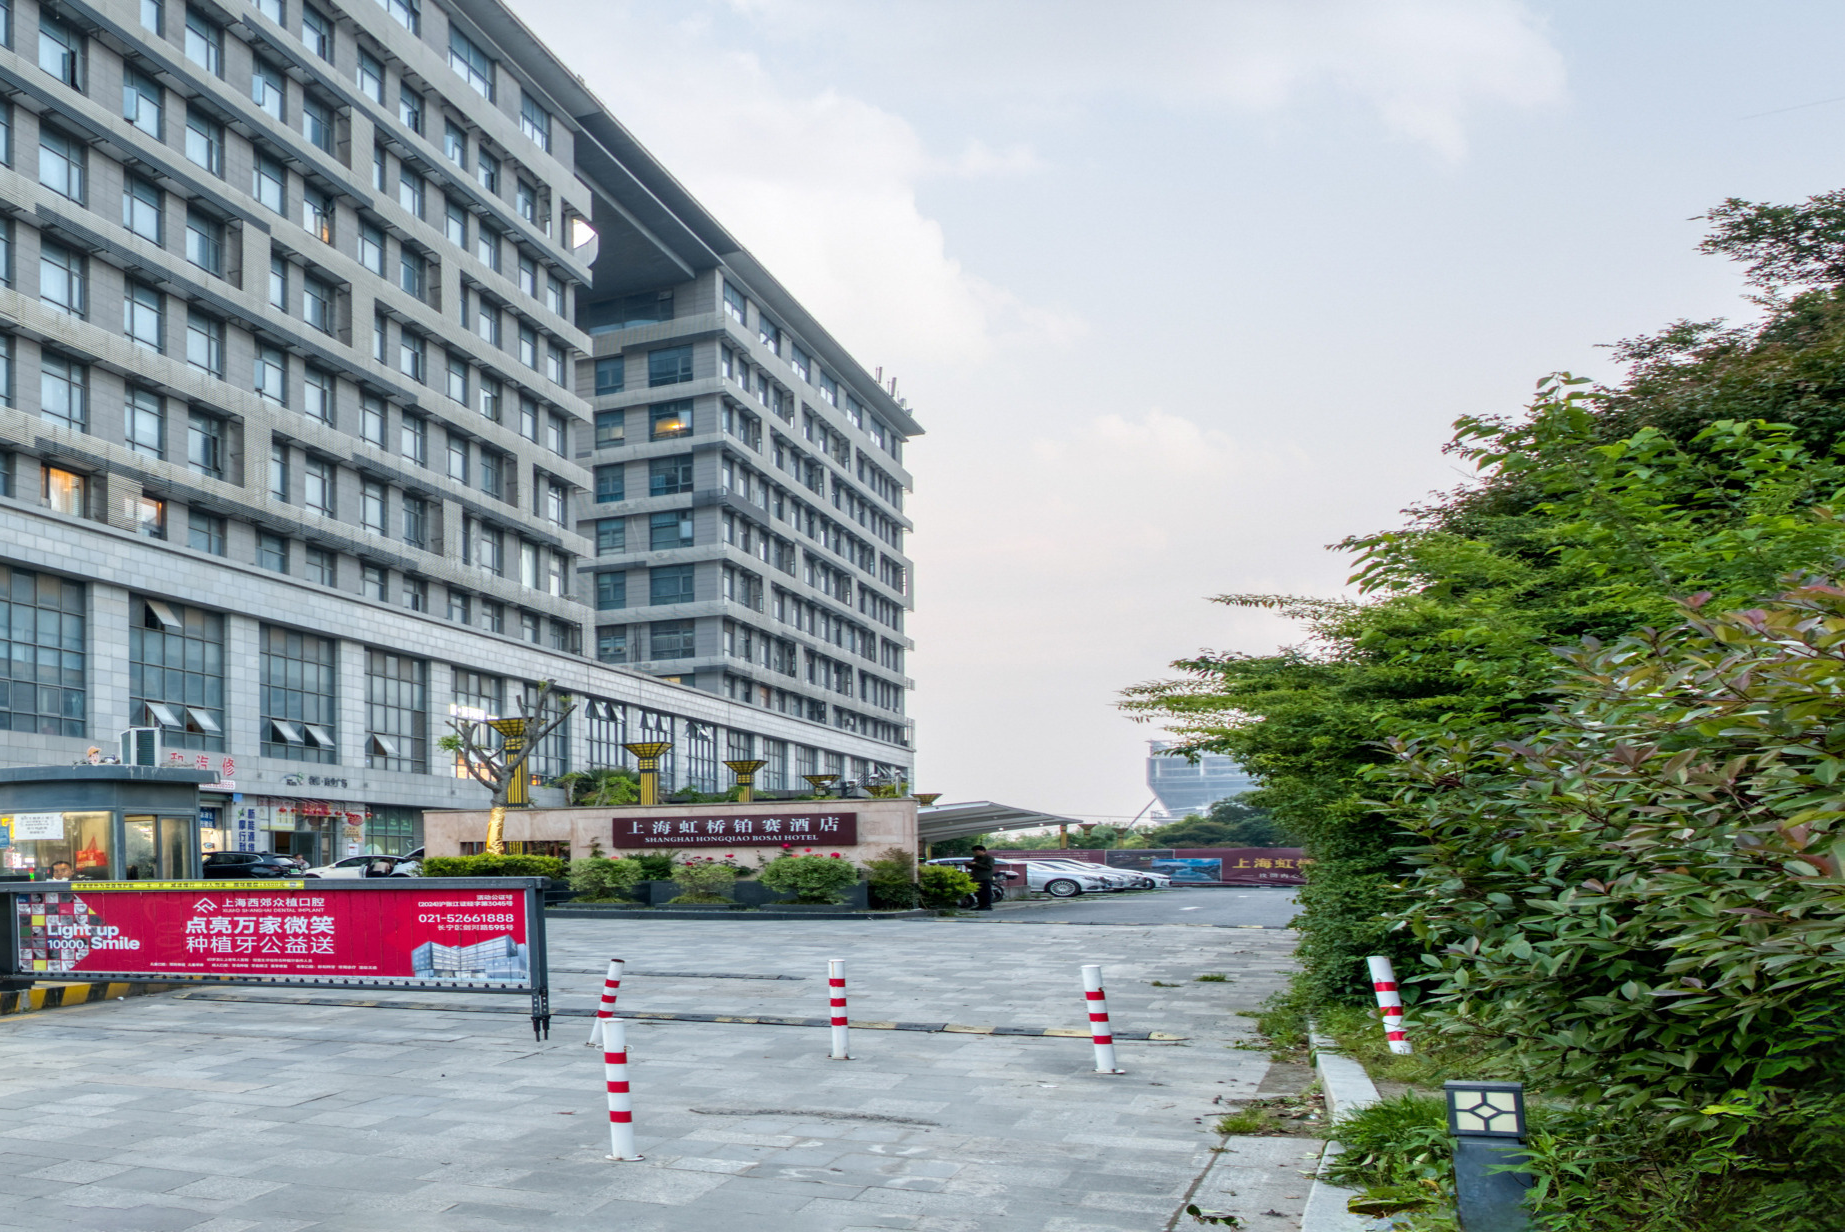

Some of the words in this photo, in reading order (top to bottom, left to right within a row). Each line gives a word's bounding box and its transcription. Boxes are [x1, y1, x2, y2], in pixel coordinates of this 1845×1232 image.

[627, 816, 840, 835] 上海虹桥铂赛酒店
[696, 835, 750, 843] HONGQIAO
[222, 897, 325, 908] 上海西郊众植口腔
[185, 916, 335, 934] 点亮万家微笑
[418, 913, 514, 923] 021-52661888
[47, 923, 92, 939] Light
[97, 925, 120, 939] up
[91, 936, 140, 950] Smile
[186, 935, 335, 955] 种植牙公益送
